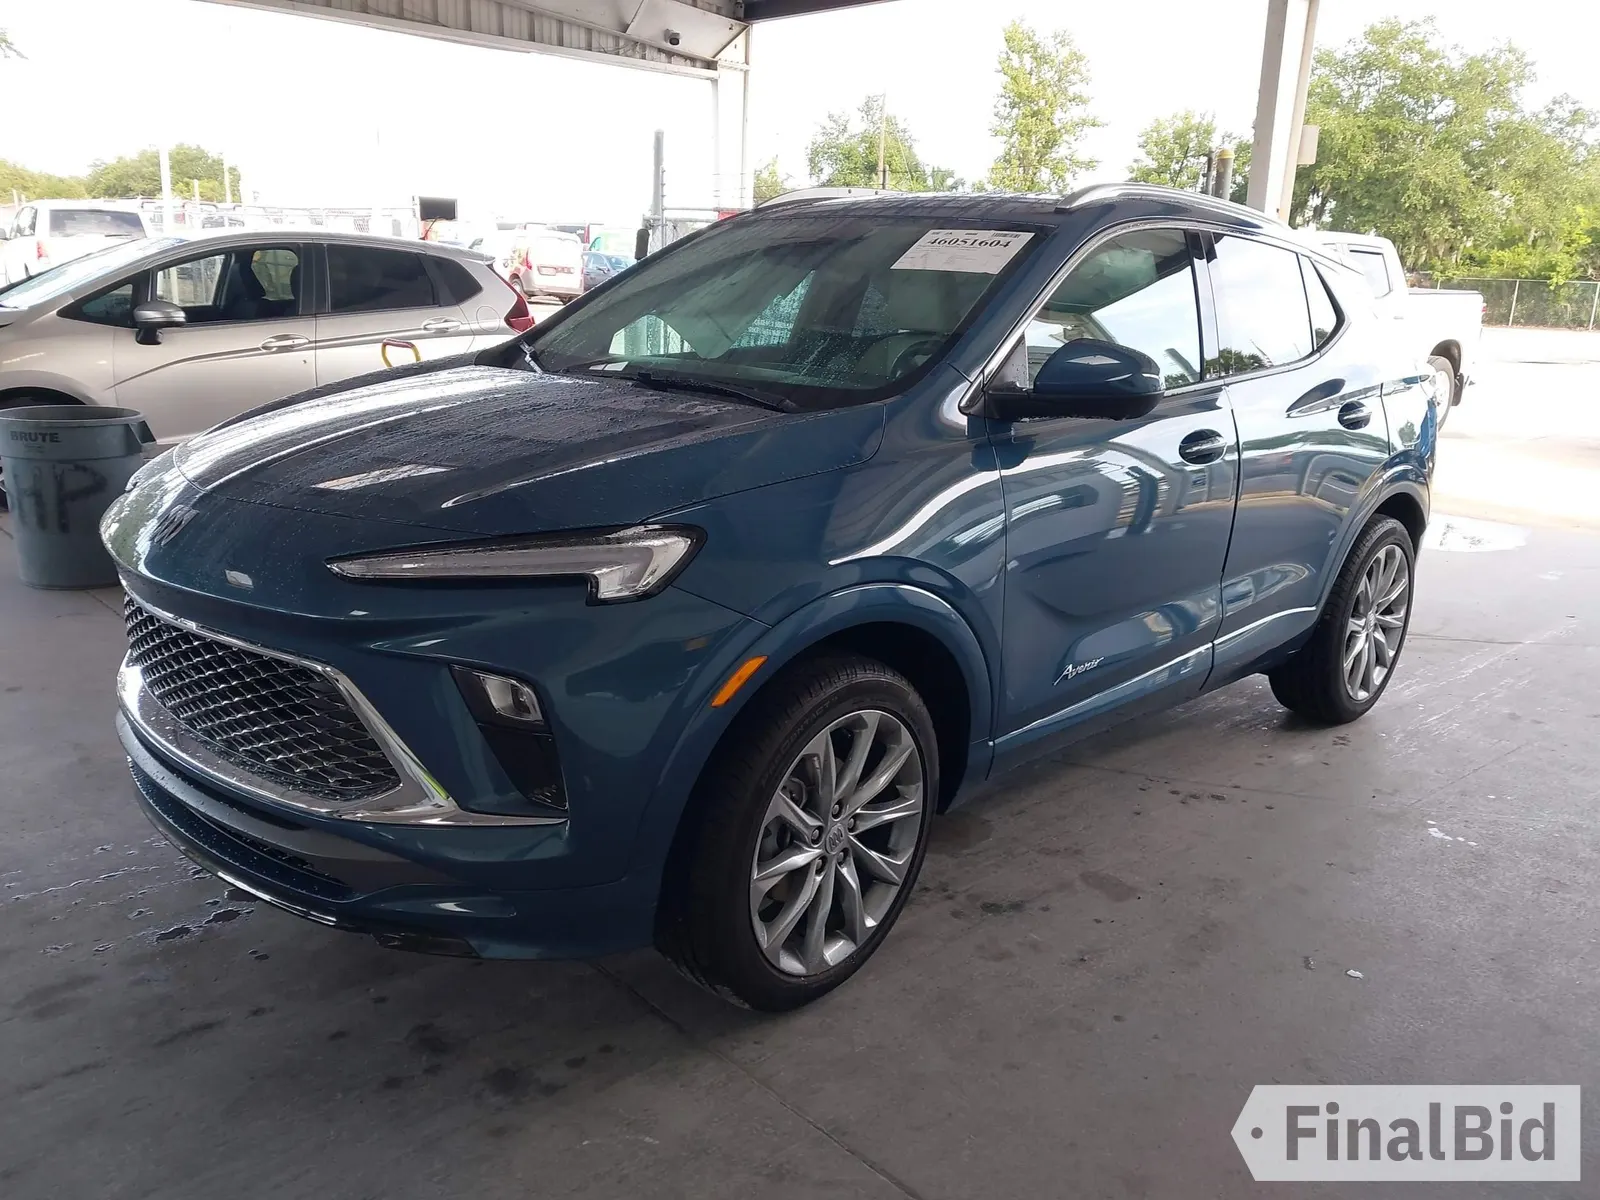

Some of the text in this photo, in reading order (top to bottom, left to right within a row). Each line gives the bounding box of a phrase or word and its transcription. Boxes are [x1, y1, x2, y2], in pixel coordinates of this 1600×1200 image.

[927, 237, 1012, 248] 46051604
[10, 430, 62, 443] BRUTE
[1053, 656, 1105, 686] Avenir
